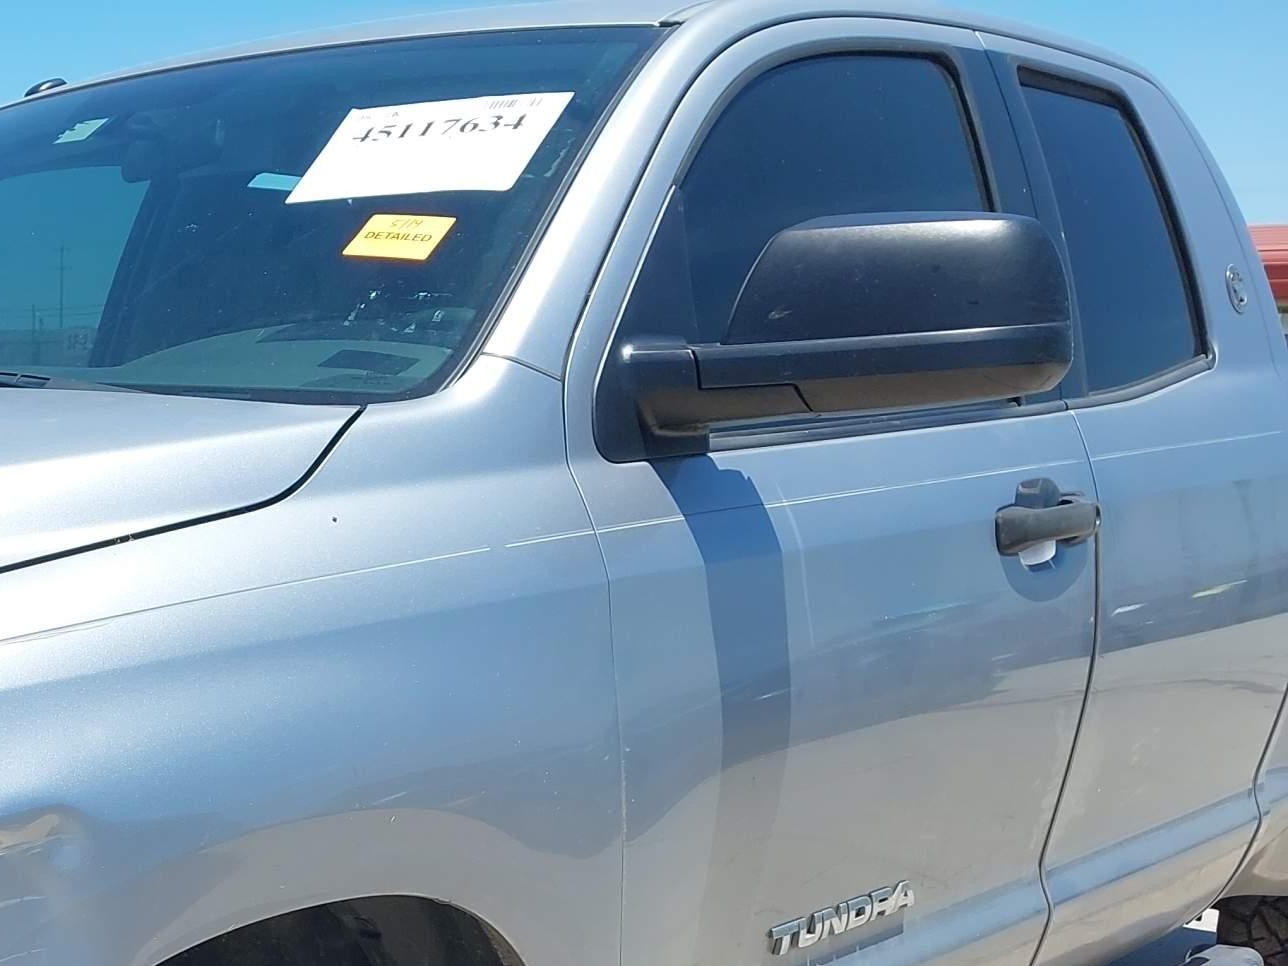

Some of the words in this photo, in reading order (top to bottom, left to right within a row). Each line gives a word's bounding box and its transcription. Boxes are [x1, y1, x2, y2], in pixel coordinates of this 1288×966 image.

[352, 113, 527, 143] 45117634
[364, 231, 433, 242] DETAILED
[767, 880, 915, 956] TUNDRA
